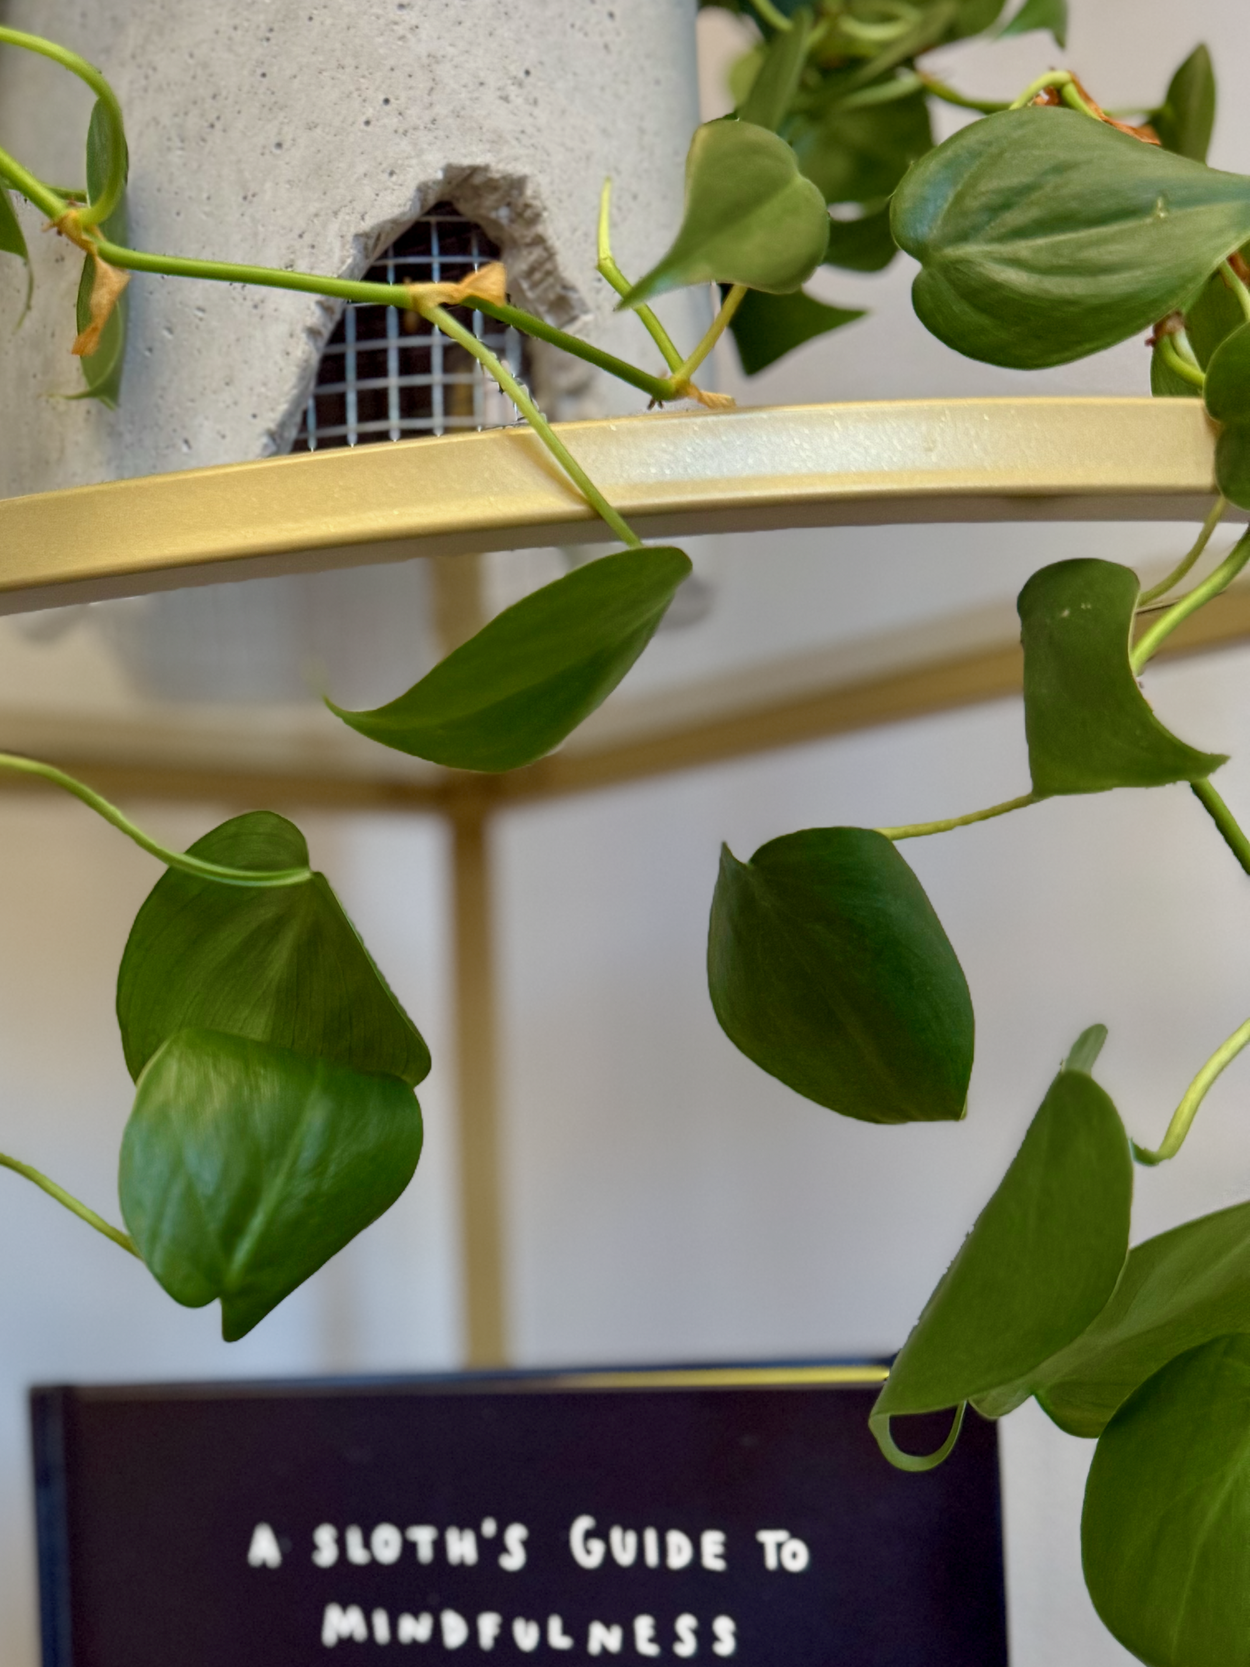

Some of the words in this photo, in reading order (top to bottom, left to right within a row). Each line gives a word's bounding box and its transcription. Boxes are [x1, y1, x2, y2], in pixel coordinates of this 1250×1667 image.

[247, 1522, 283, 1568] A
[312, 1516, 529, 1572] SLOTH'S
[569, 1514, 728, 1572] GUIDE
[321, 1602, 737, 1658] MINDFULNESS
